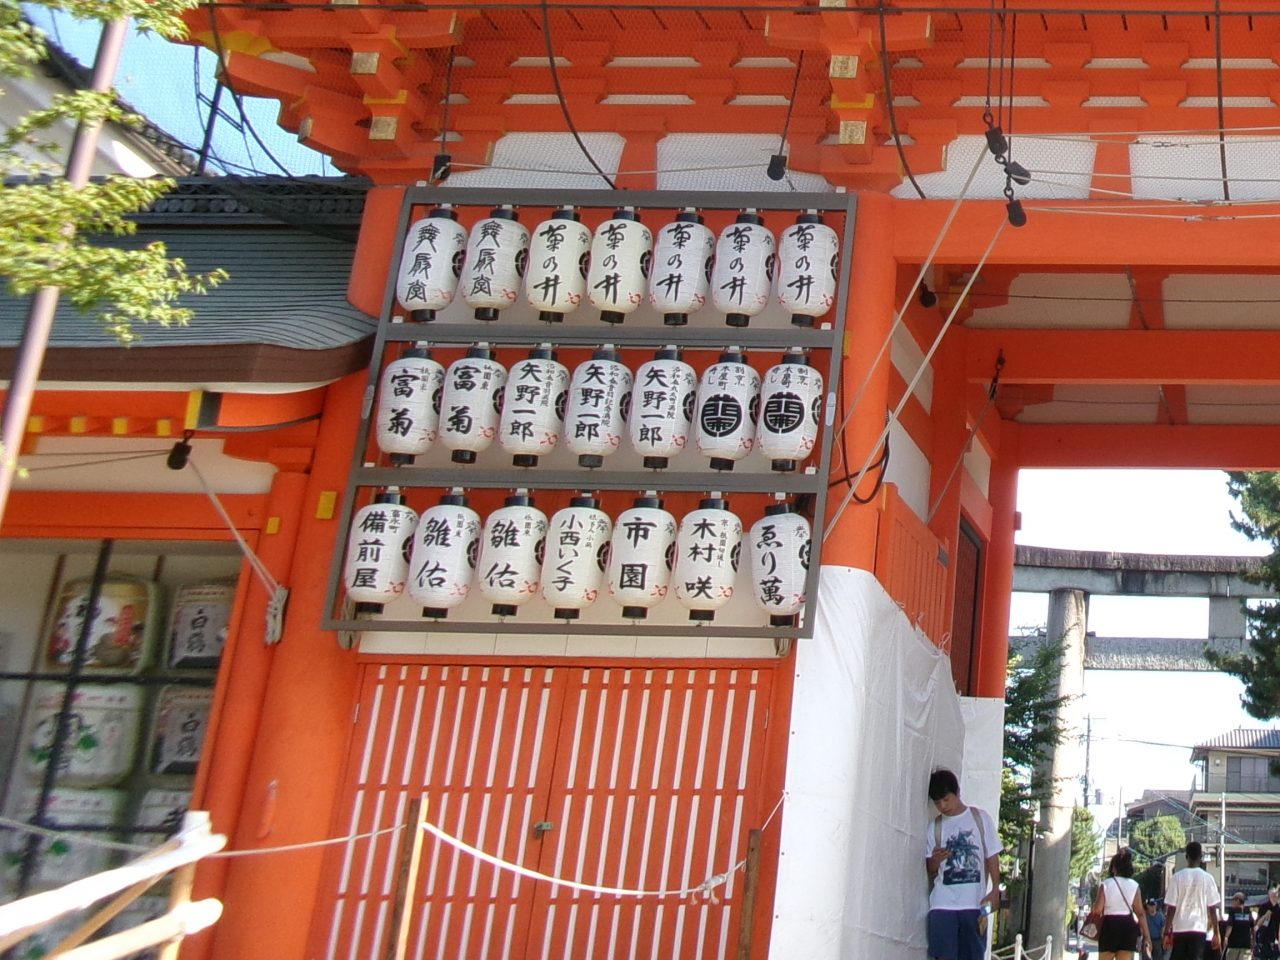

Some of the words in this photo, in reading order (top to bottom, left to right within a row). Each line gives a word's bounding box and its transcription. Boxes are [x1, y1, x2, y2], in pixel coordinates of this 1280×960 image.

[387, 368, 421, 438] 富菊
[447, 365, 481, 434] 富菊
[509, 361, 543, 443] 矢野一郎
[574, 363, 604, 443] 矢野一郎
[639, 366, 670, 447] 矢野一郎
[351, 510, 389, 589] 備前屋
[552, 514, 583, 591] 小西いく子
[619, 517, 657, 591] 市園
[685, 518, 718, 599] 木村咲
